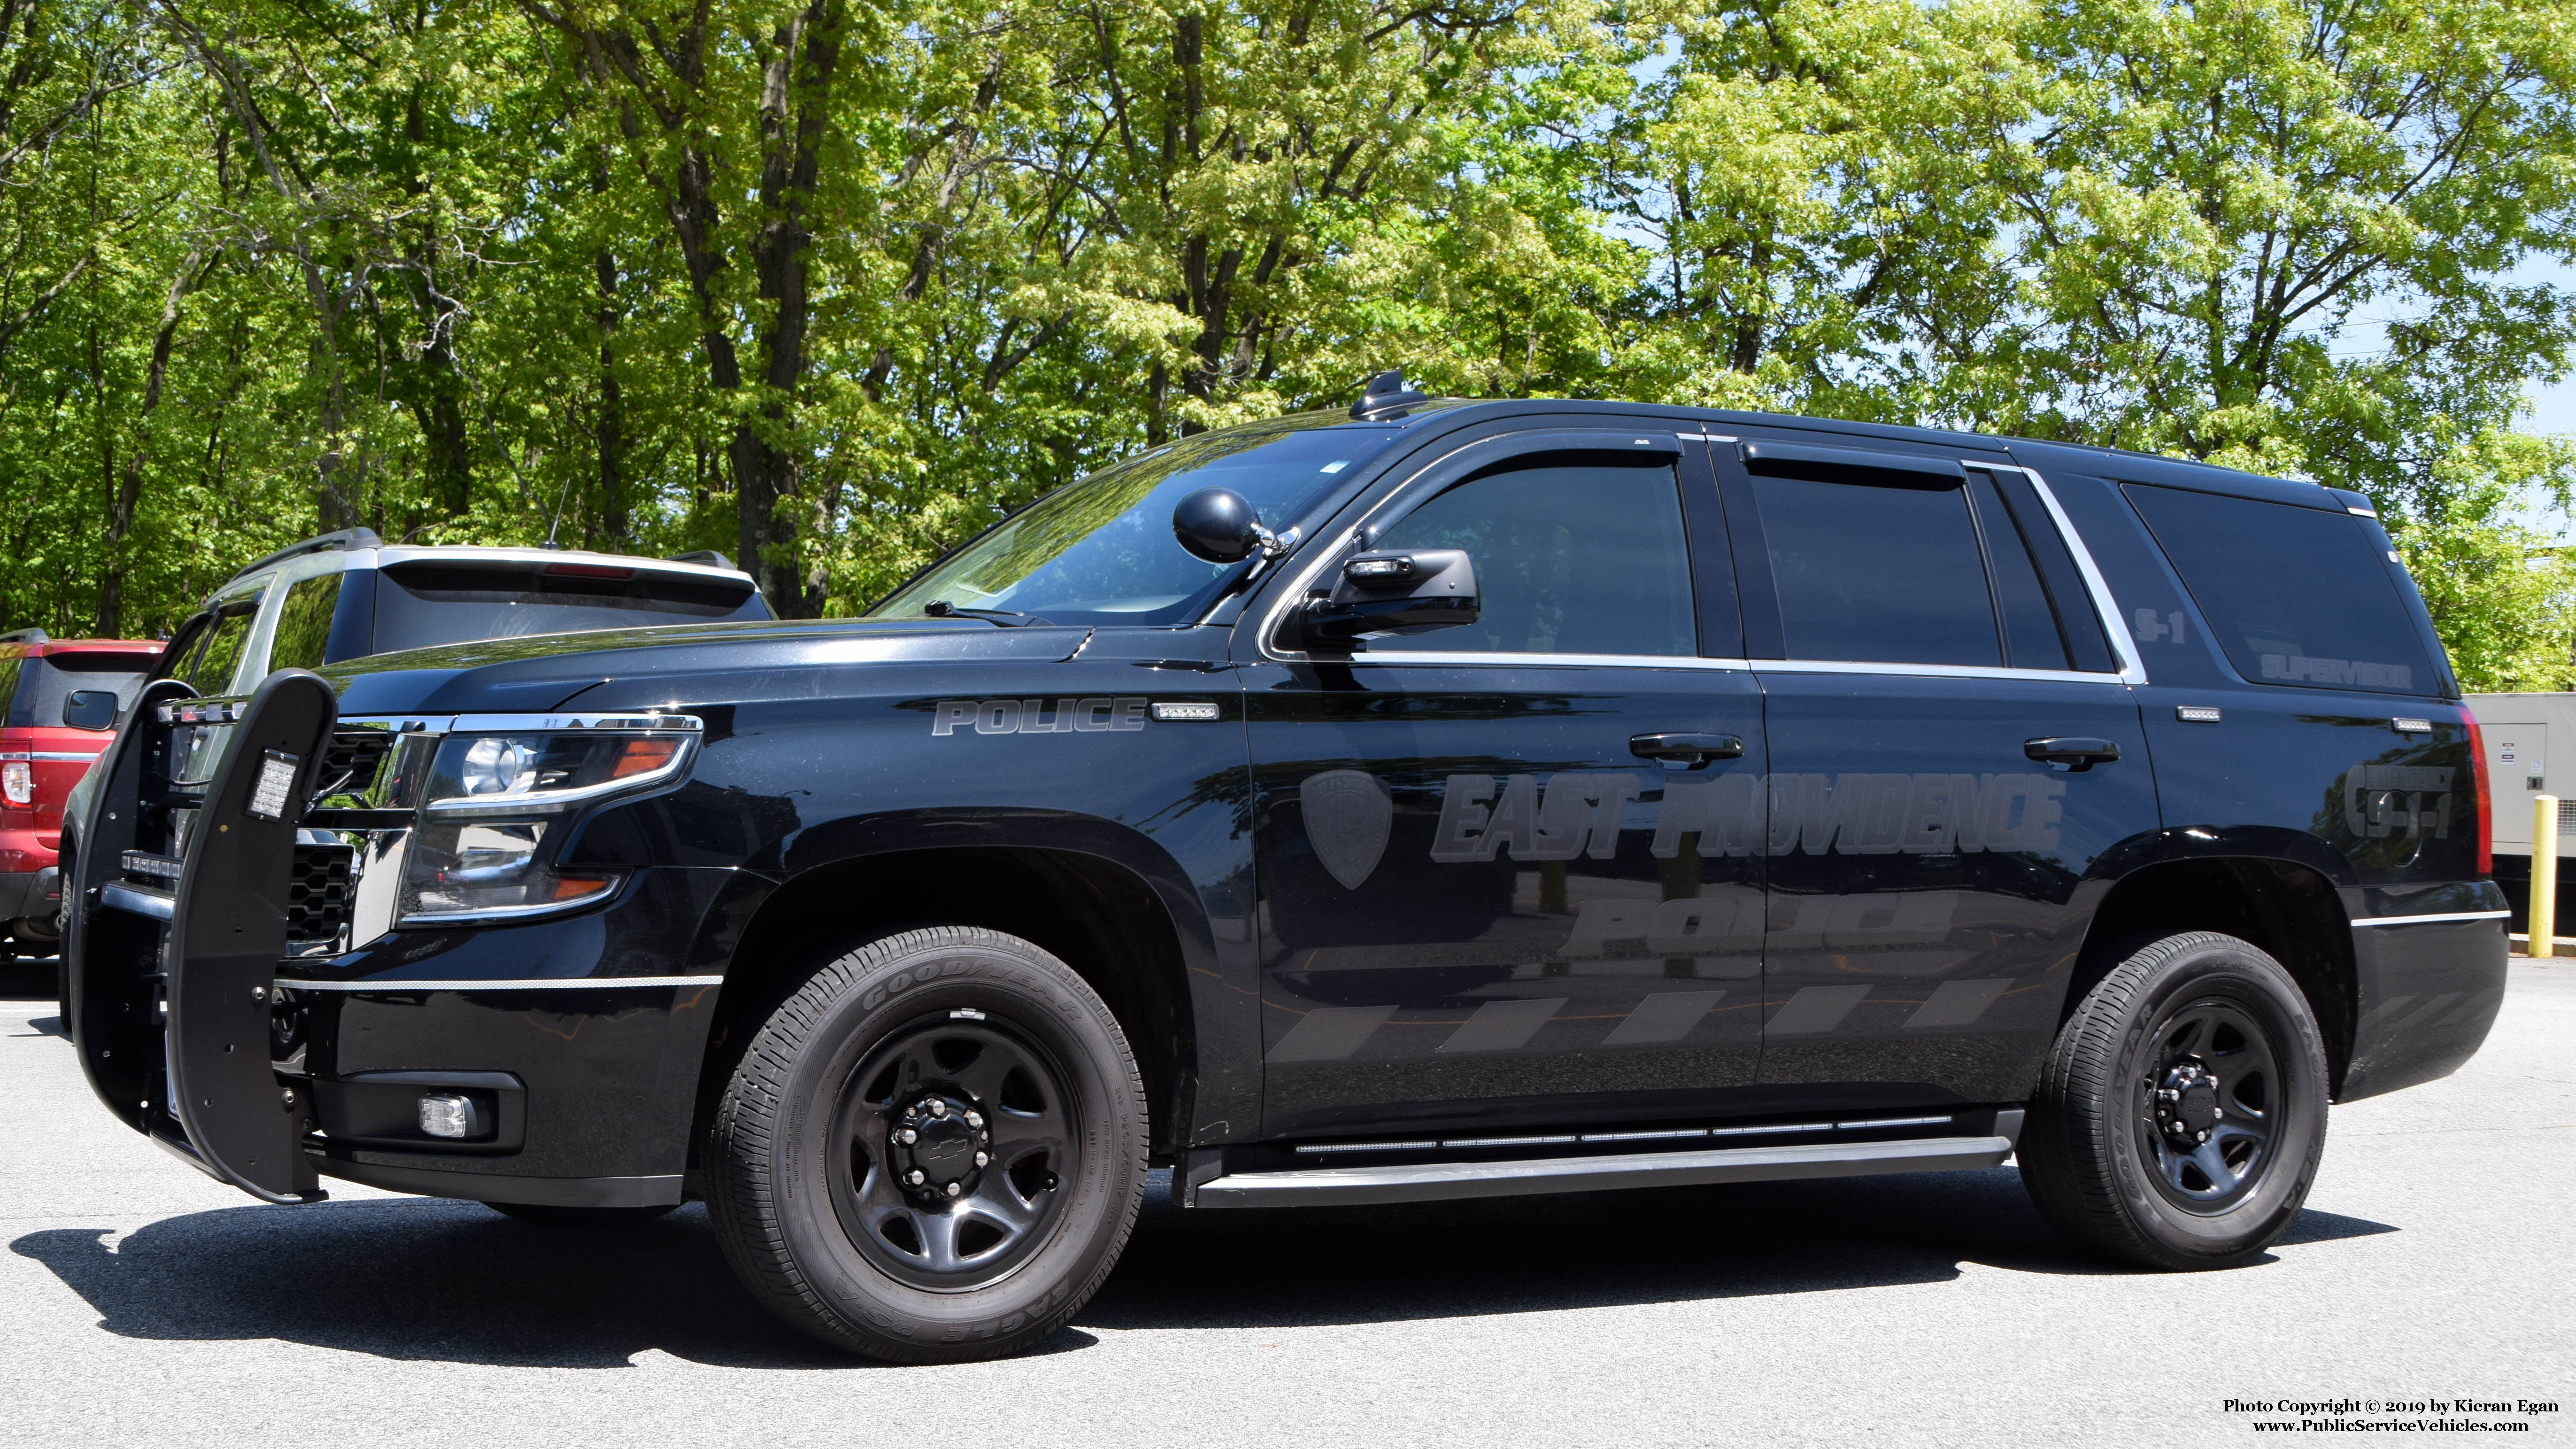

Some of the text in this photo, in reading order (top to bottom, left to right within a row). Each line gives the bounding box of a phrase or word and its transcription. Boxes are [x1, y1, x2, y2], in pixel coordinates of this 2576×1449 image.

[2135, 608, 2185, 643] S-1
[2261, 653, 2412, 689] SUPERVISOR
[932, 697, 1147, 736] POLICE
[1430, 773, 2066, 863] EAST PROVIDENCE
[1558, 892, 1959, 957] POLICE
[863, 960, 1084, 1022] GOODYEAR
[2113, 1003, 2153, 1199] GOODYEAR
[941, 1277, 1070, 1342] EAGLE
